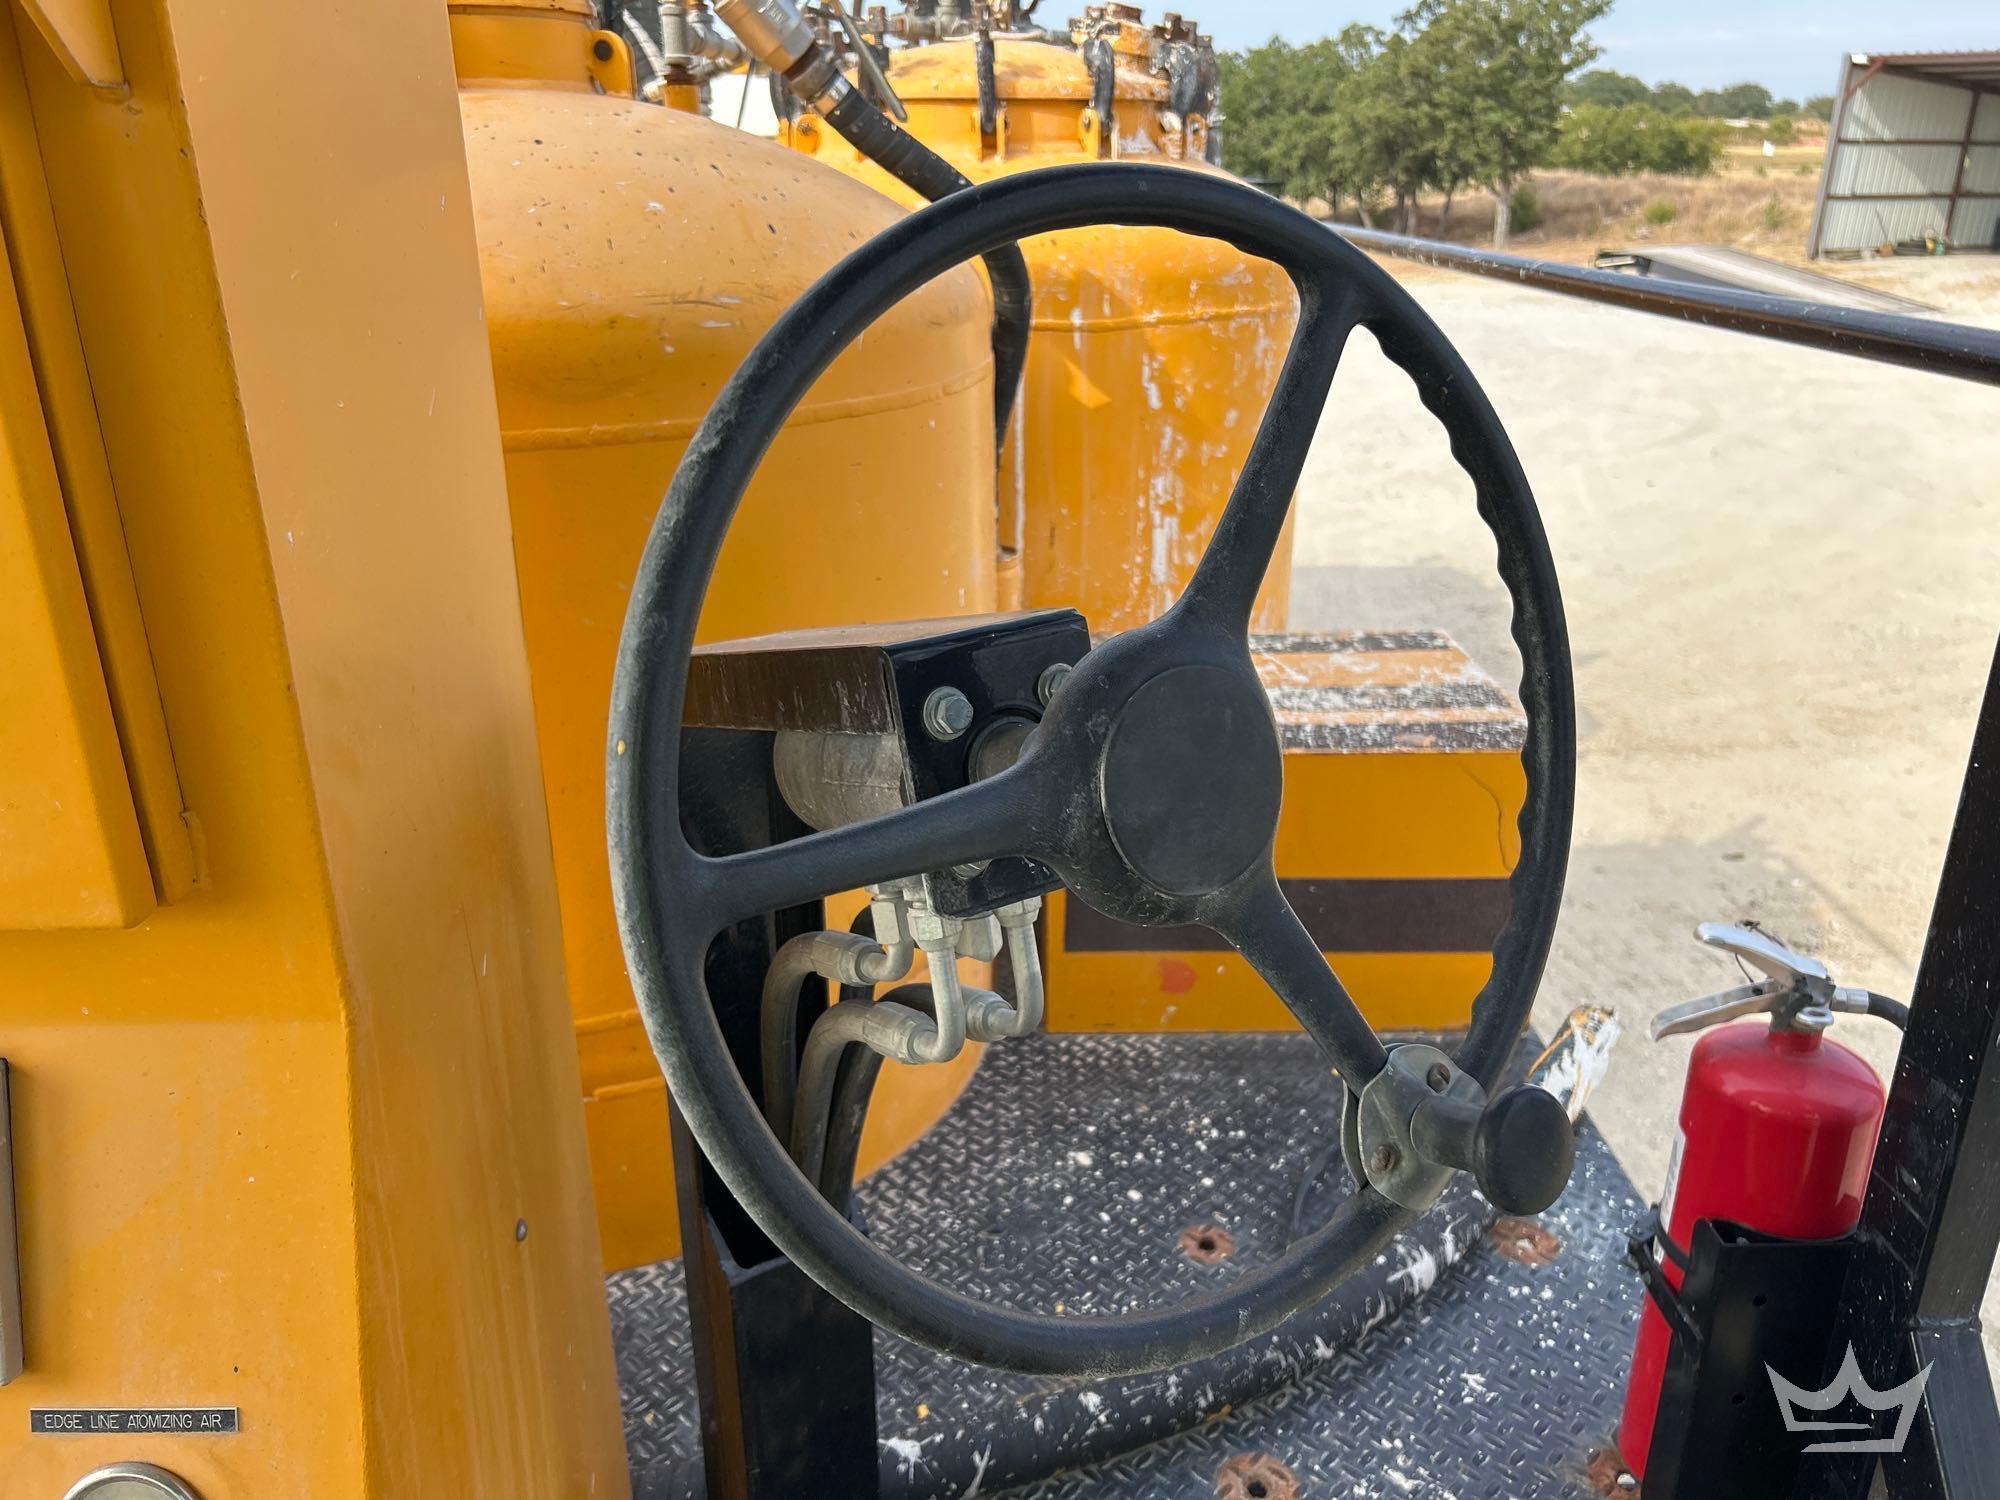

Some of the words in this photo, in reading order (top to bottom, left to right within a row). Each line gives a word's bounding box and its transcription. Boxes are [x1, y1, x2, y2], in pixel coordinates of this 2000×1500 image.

[44, 1414, 82, 1429] EDGE
[90, 1414, 119, 1429] LINE
[127, 1414, 192, 1429] ATOMIZING
[200, 1414, 222, 1429] AIR
